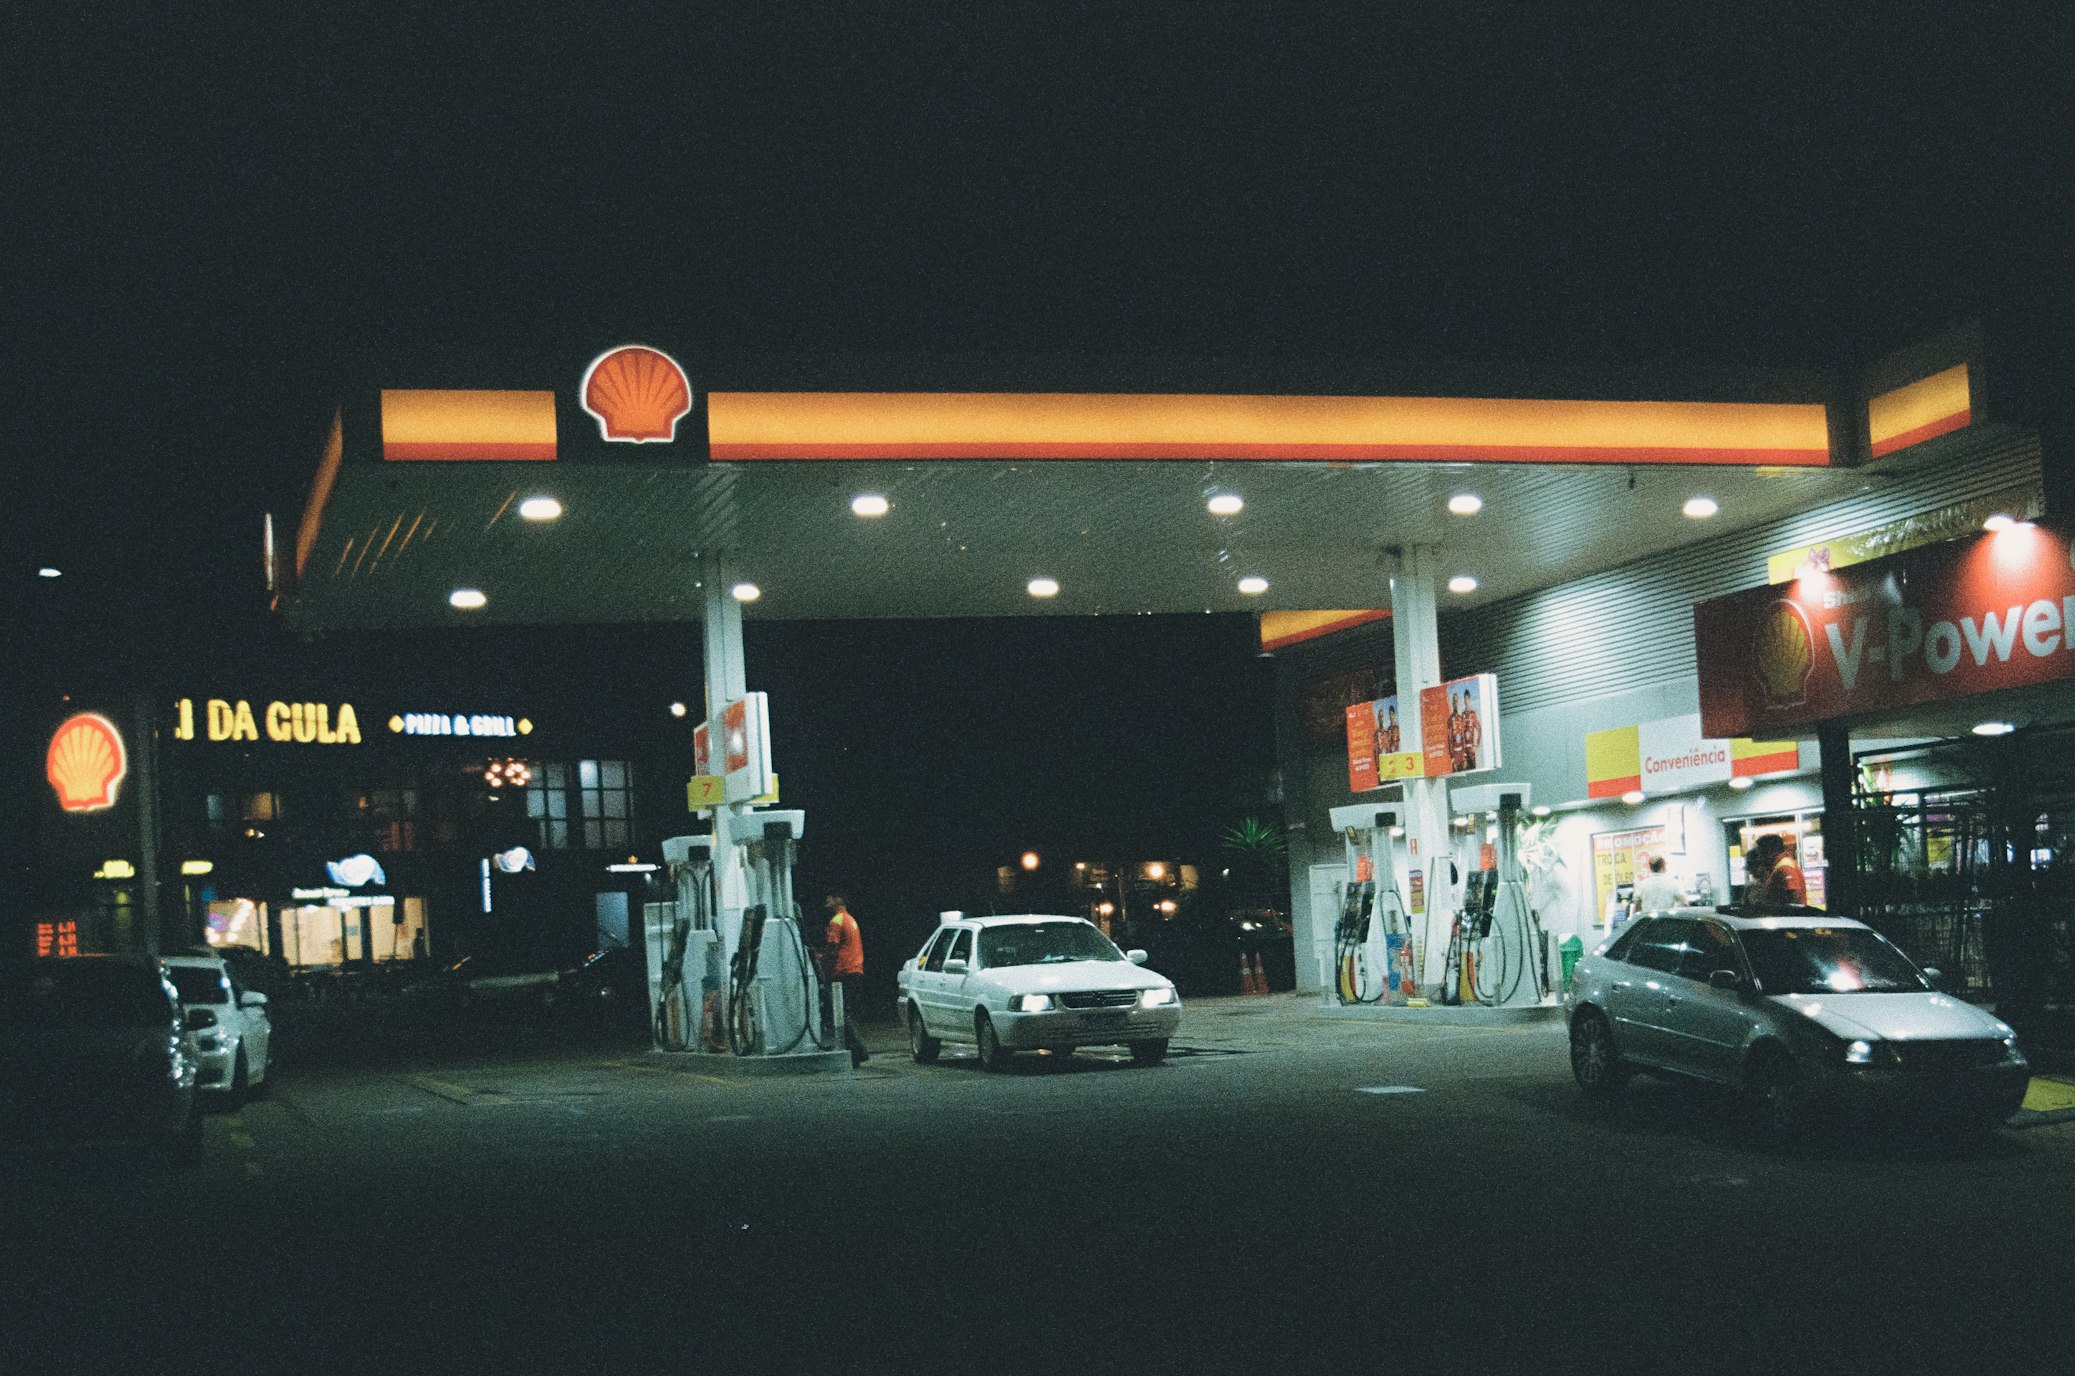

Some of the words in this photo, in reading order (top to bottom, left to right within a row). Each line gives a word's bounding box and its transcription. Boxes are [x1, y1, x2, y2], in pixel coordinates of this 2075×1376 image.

[207, 699, 258, 741] DA
[266, 701, 361, 744] GULA
[1405, 756, 1415, 770] 3
[1645, 745, 1726, 775] Conveniência
[702, 782, 712, 796] 7
